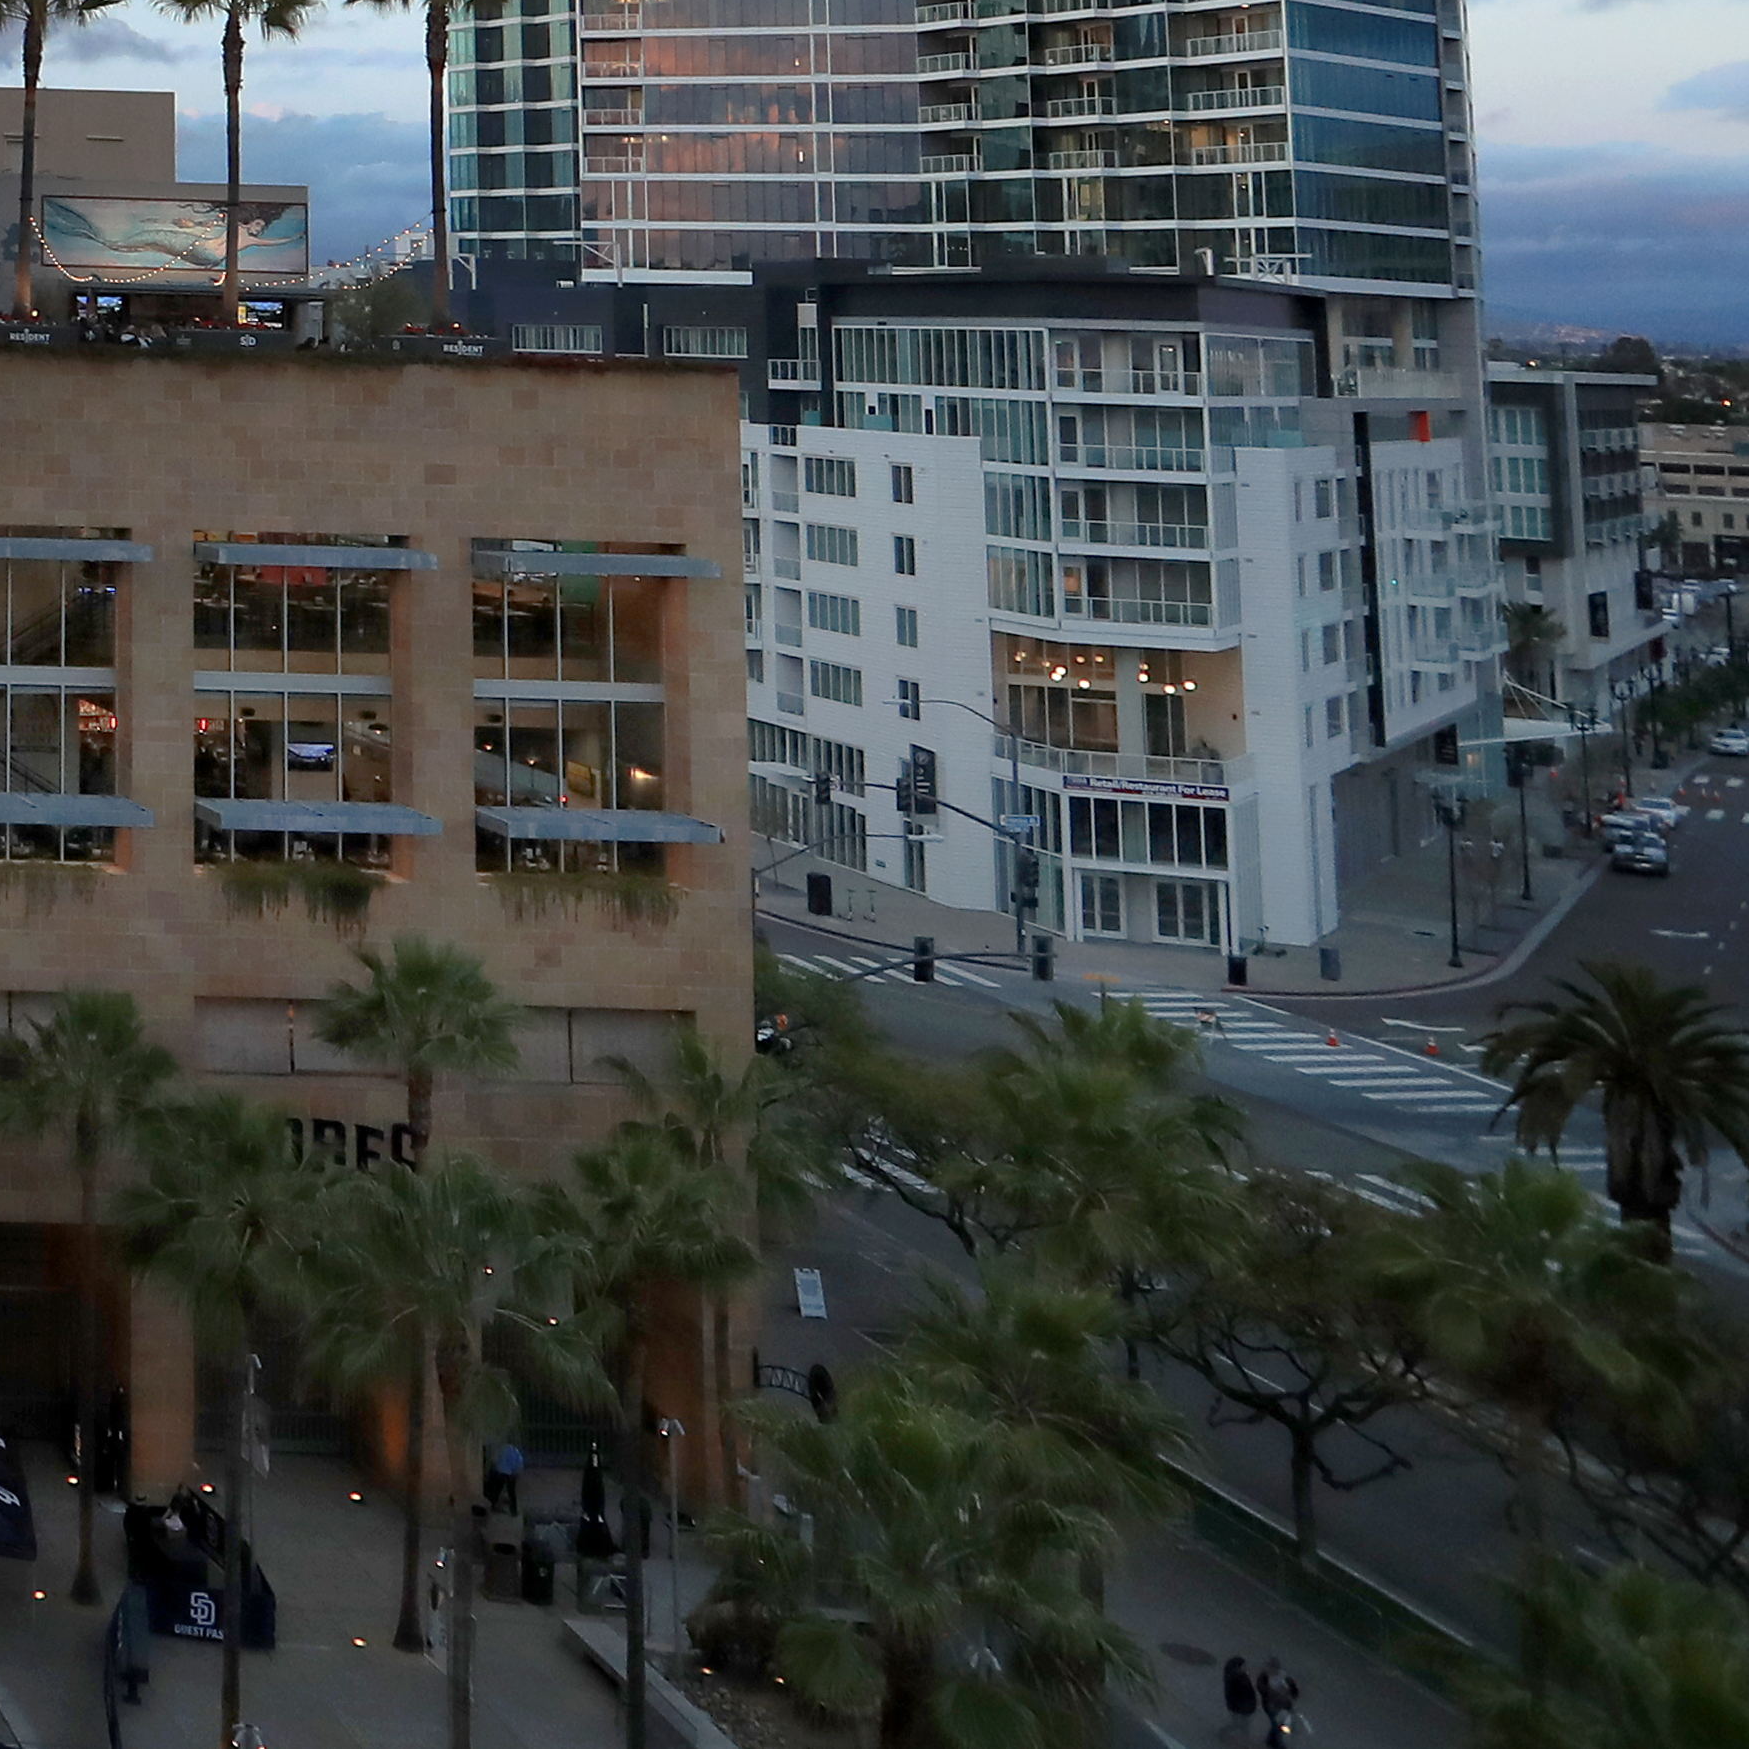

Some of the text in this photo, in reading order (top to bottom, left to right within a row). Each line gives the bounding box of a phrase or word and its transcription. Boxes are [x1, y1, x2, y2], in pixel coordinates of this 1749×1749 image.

[1178, 785, 1196, 795] For
[1197, 787, 1226, 798] Lease
[190, 1591, 216, 1626] SD
[206, 1626, 224, 1640] PAS
